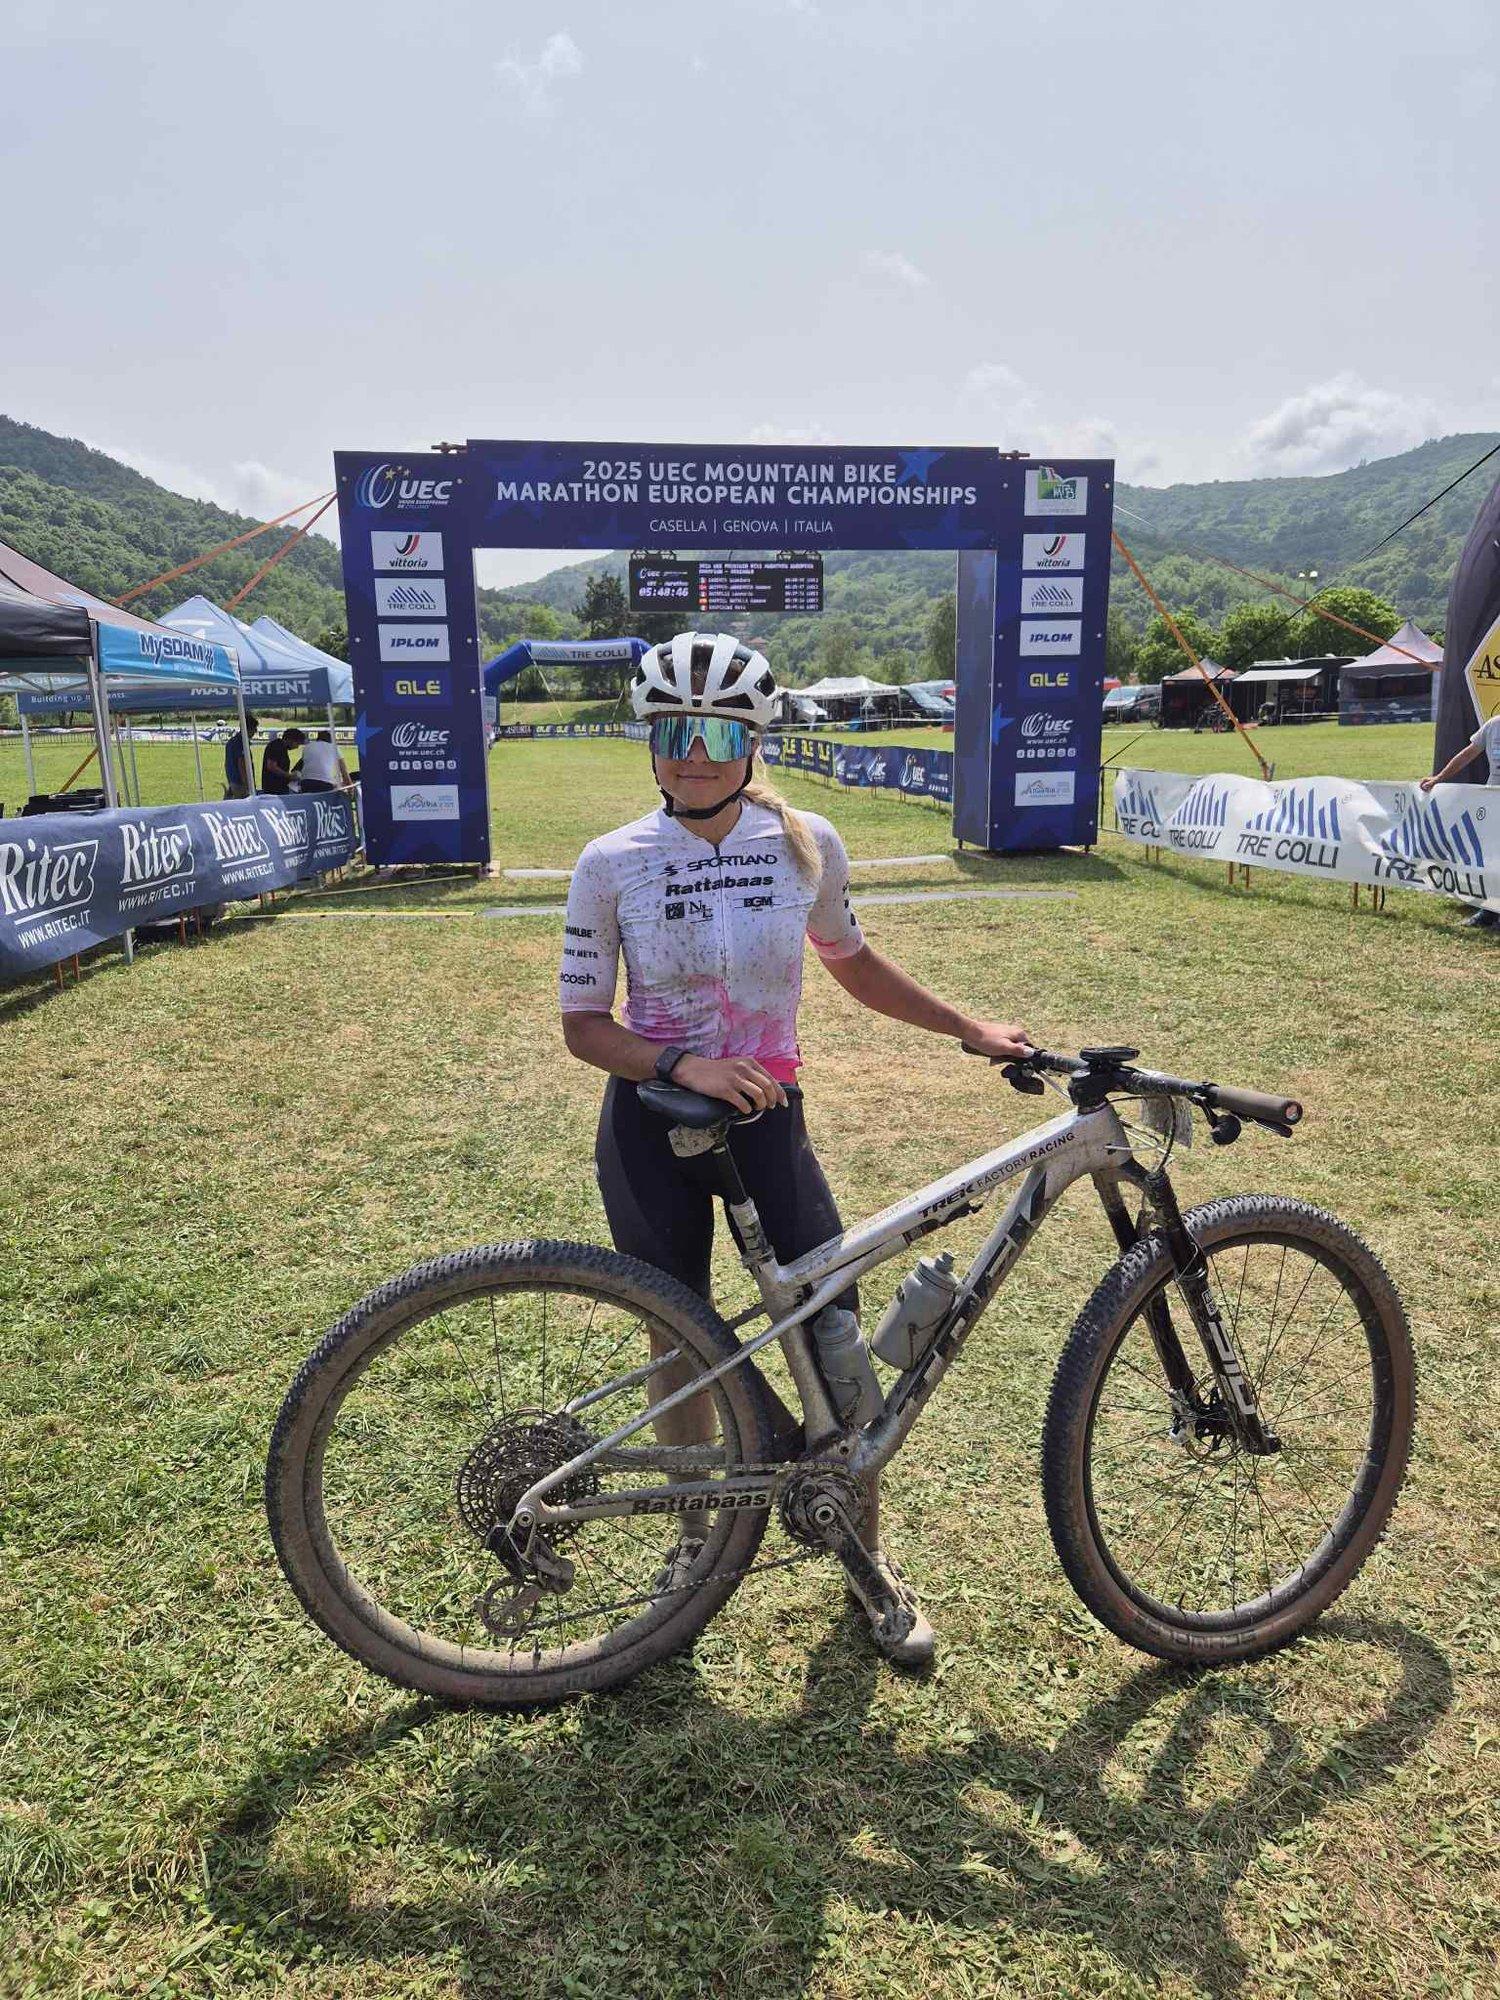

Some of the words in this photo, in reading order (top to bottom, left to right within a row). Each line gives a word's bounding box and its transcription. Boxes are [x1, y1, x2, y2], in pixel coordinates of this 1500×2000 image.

[582, 460, 642, 480] 2025
[648, 461, 698, 482] UEC
[704, 462, 838, 484] MOUNTAIN
[844, 464, 897, 483] BIKE
[399, 480, 453, 500] UEC
[497, 481, 639, 503] MARATHON
[648, 483, 780, 505] EUROPEAN
[786, 486, 977, 506] CHAMPIONSHIPS
[649, 519, 707, 533] CASELLA
[723, 520, 779, 533] GENOVA
[794, 520, 833, 533] ITALIA
[388, 557, 429, 568] vittoria
[1036, 557, 1071, 568] vittoria
[387, 602, 405, 610] TRE
[407, 602, 437, 610] COLLI
[390, 638, 440, 649] IPLOM
[1029, 632, 1073, 643] IPLOM
[571, 650, 592, 659] TRE
[594, 648, 627, 657] COLLI
[417, 730, 450, 742] UEC
[1044, 720, 1074, 732] UEC
[200, 811, 261, 861] Ritec
[1169, 829, 1186, 848] TRE
[1187, 829, 1222, 850] COLLI
[118, 821, 185, 885] Ritec
[1236, 833, 1273, 858] TRE
[1274, 839, 1339, 869] COLLI
[221, 862, 275, 886] WWW.RITEC.IT
[686, 854, 778, 872] SPORTLAND
[0, 838, 87, 915] Ritec
[665, 875, 774, 897] Rattabaas
[1427, 865, 1488, 900] COLLI
[118, 881, 196, 913] WWW.RITEC.IT
[18, 910, 91, 950] WWW.RITEC.IT
[918, 1182, 975, 1219] TREK
[976, 1156, 1029, 1188] FACTORY
[1028, 1132, 1076, 1160] RACING
[631, 1493, 767, 1515] Rattabaas
